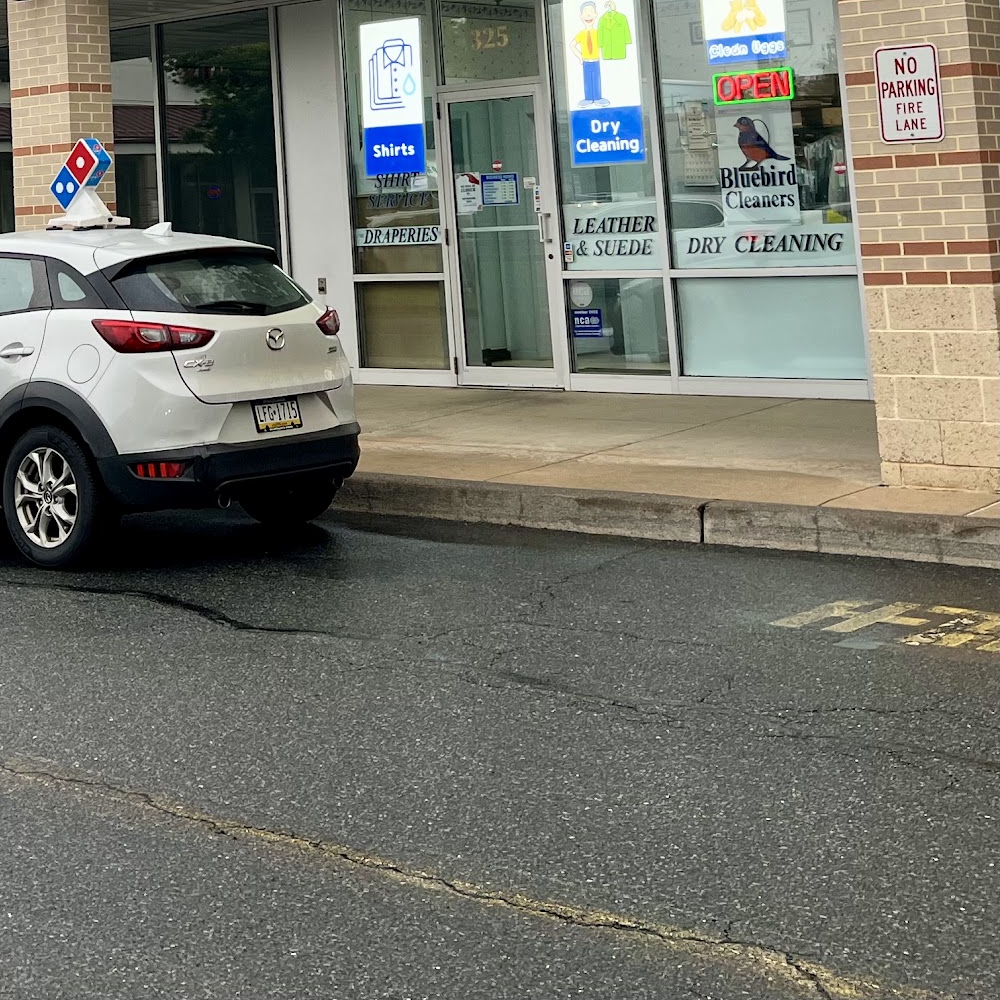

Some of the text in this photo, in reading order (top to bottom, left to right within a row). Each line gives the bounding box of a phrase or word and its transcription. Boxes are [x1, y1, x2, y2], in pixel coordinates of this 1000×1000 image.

[471, 25, 509, 50] 325
[709, 38, 785, 60] Clean Uggs
[894, 56, 917, 76] NO
[717, 70, 791, 102] OPEN
[881, 78, 935, 99] PARKING
[896, 101, 924, 115] FIRE
[590, 119, 620, 135] Dry
[895, 117, 927, 132] LANE
[373, 143, 415, 158] Shirts
[576, 137, 640, 155] Cleaning
[374, 171, 420, 188] SHIRT
[720, 164, 797, 189] Bluebird
[368, 192, 429, 209] SERVICE
[725, 190, 795, 209] Cleaners
[573, 215, 656, 235] LEATHER
[364, 226, 439, 245] DRAPERIES
[687, 233, 844, 254] DRY CLEANING
[576, 238, 654, 257] & SUEDE
[574, 316, 590, 325] nca
